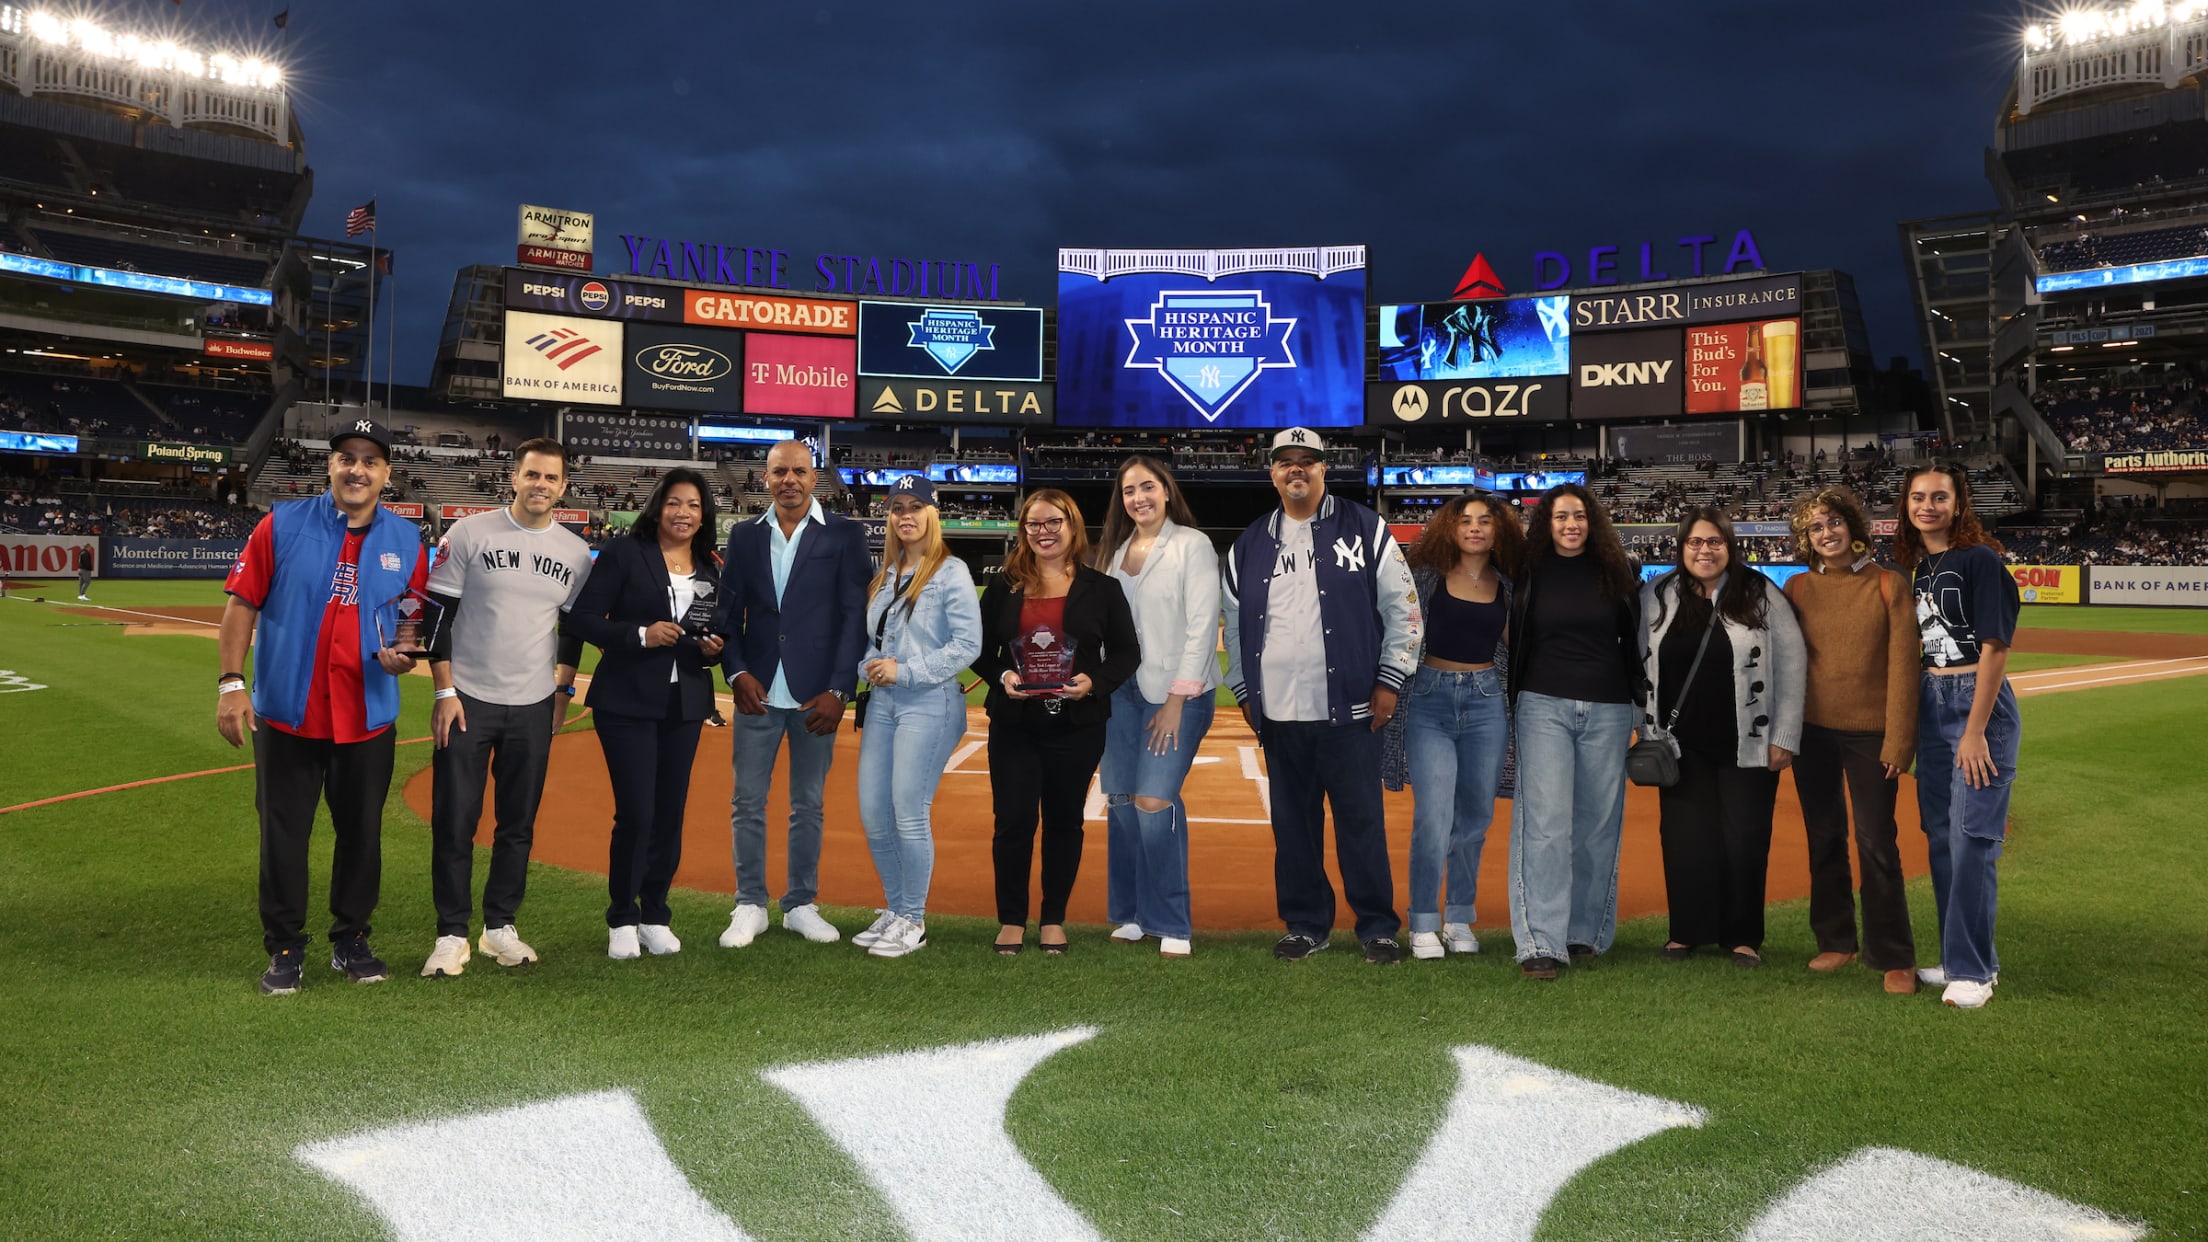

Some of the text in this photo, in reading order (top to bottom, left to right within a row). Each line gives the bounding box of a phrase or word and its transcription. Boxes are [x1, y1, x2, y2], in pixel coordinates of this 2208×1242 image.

[525, 211, 590, 228] ARMITRON
[528, 248, 586, 263] ARMITRON
[1533, 228, 1766, 291] DELTA
[619, 234, 1000, 300] YANKEE STADIUM
[523, 283, 565, 298] PEPSI
[582, 292, 608, 300] PEPSI
[625, 294, 666, 309] PEPSI
[1575, 287, 1797, 327] STARR INSURANCE
[695, 297, 849, 329] GATORADE
[1164, 311, 1257, 325] HISPANIC
[925, 326, 978, 335] HERITAGE
[928, 319, 976, 328] HISPANIC
[932, 334, 969, 342] MONTH
[1160, 326, 1262, 339] HERITAGE
[2134, 327, 2153, 336] 2021
[1692, 331, 1728, 347] This
[225, 345, 272, 358] Budweiser
[1173, 341, 1245, 353] MONTH
[1692, 346, 1736, 362] Bud's
[652, 348, 713, 378] Ford
[775, 366, 849, 389] Mobile
[1580, 360, 1673, 387] DKNY
[1692, 364, 1719, 377] For
[506, 376, 618, 394] BANK OF AMERICA
[652, 382, 715, 393] BuyFordNow.com
[1692, 379, 1727, 393] You.
[916, 388, 1042, 415] DELTA
[1442, 383, 1542, 418] razr
[355, 419, 373, 433] NY
[1291, 430, 1305, 443] NY
[147, 443, 223, 463] Poland Spring
[1666, 453, 1712, 462] THE BOSS
[2105, 454, 2142, 468] Parts
[899, 475, 914, 489] NY
[394, 506, 416, 516] Farm
[559, 512, 579, 521] Farm
[113, 545, 189, 559] Montefiore
[1332, 534, 1366, 572] NY
[482, 550, 573, 586] NEW YORK
[2094, 581, 2136, 590] BANK
[2141, 581, 2161, 591] OF
